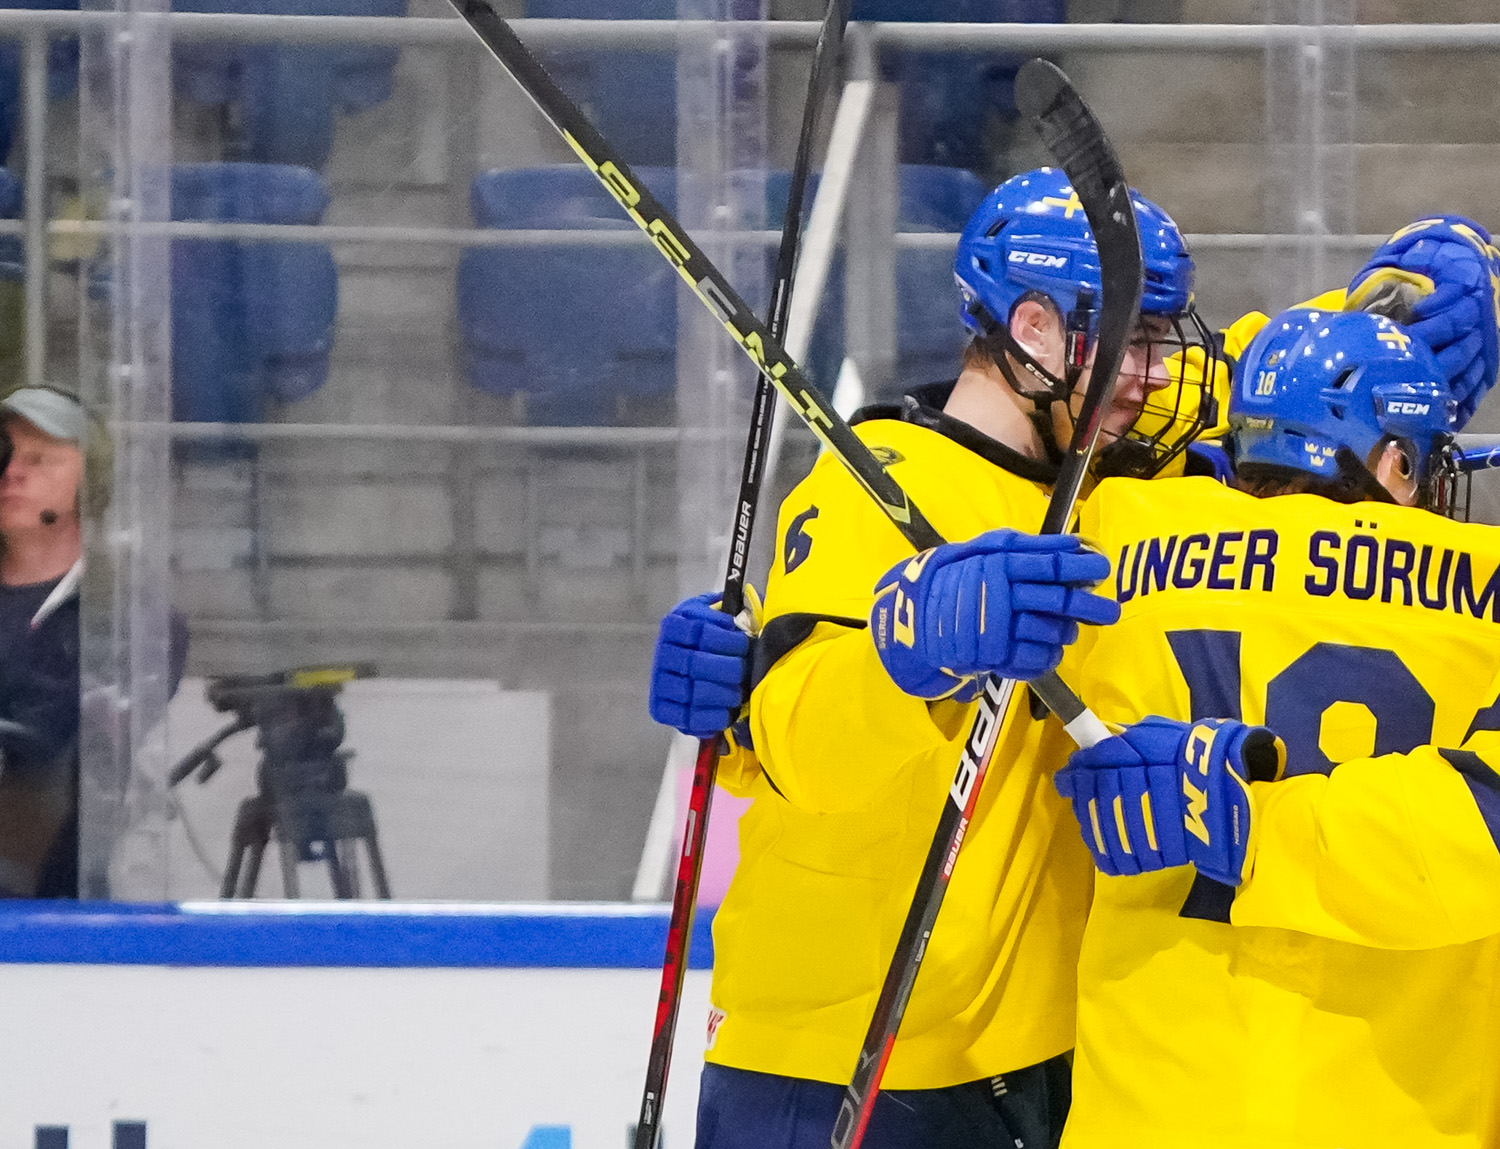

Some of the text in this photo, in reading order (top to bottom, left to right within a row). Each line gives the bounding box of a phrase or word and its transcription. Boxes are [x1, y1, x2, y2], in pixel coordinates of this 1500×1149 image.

[1007, 250, 1068, 269] CCM
[1025, 362, 1054, 387] CCM
[1387, 401, 1430, 415] CCM
[783, 503, 820, 576] 6
[1116, 528, 1279, 604] UNGER
